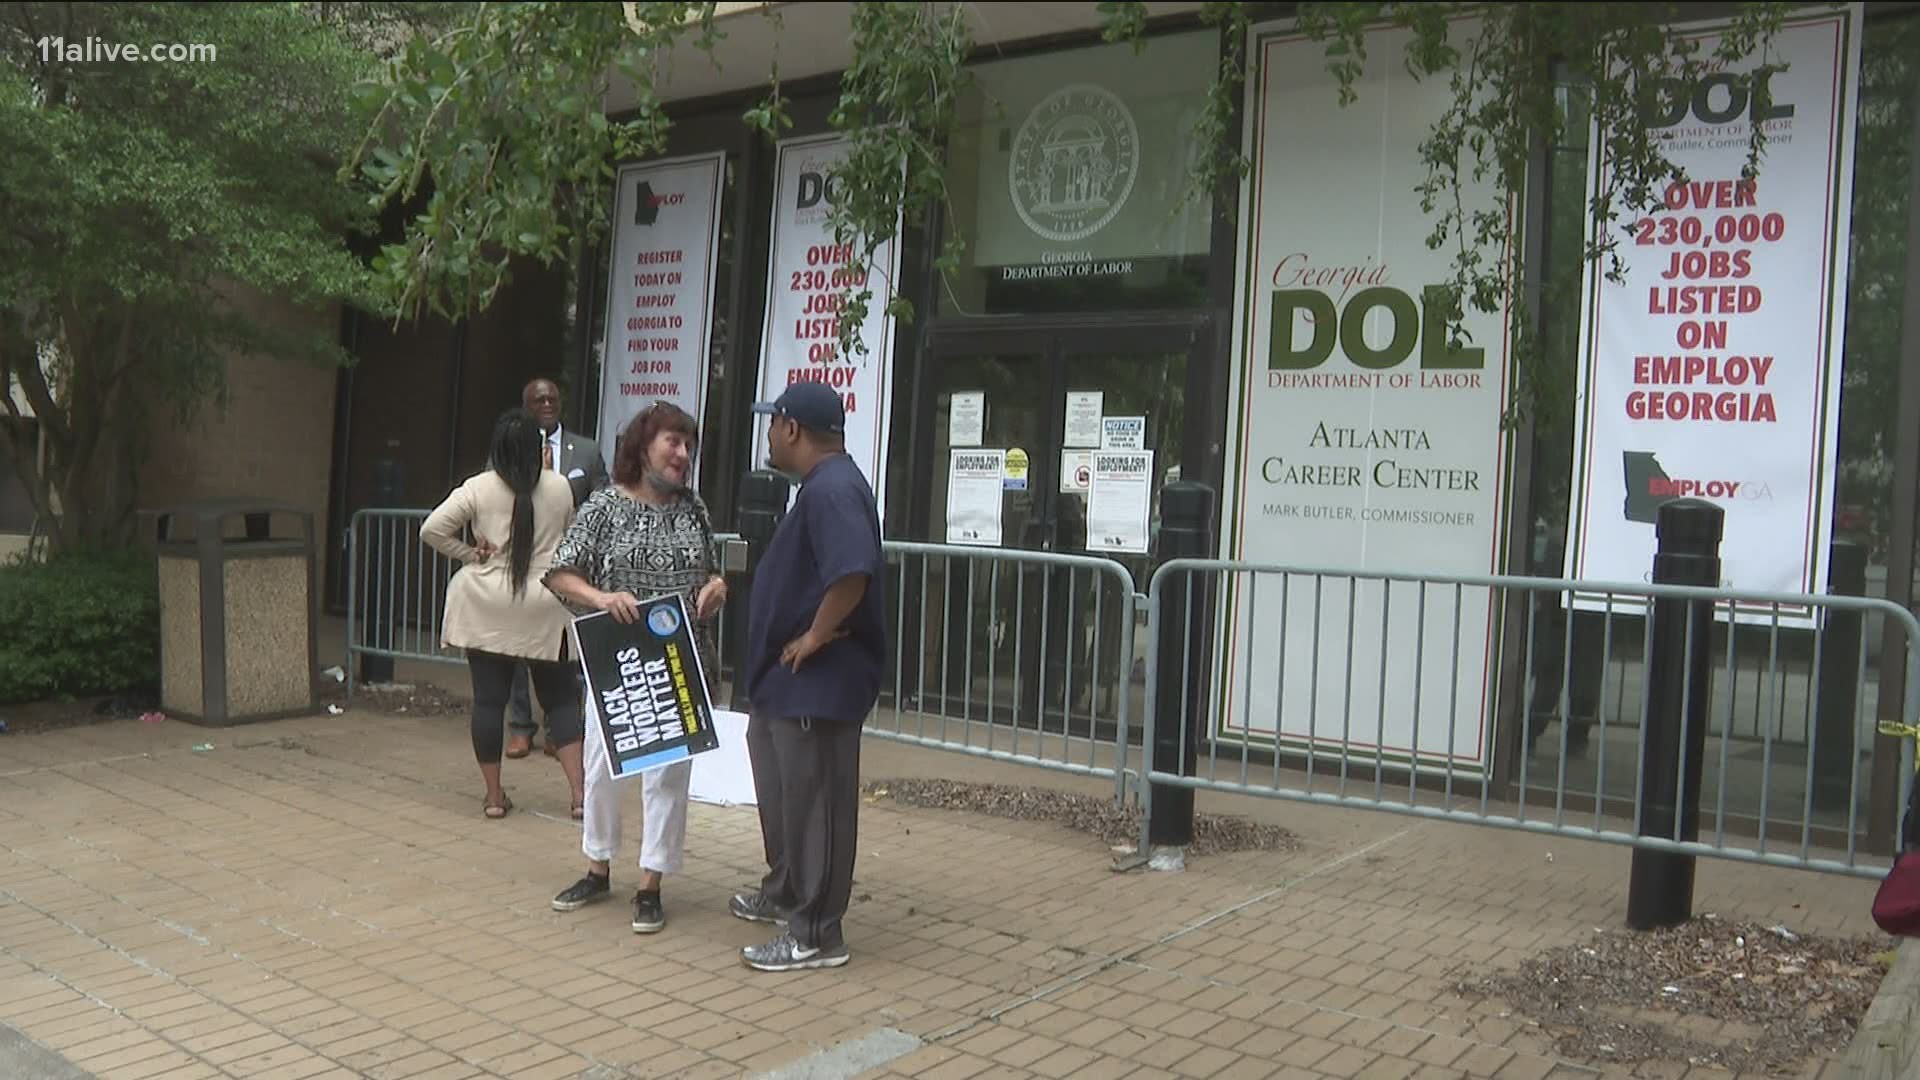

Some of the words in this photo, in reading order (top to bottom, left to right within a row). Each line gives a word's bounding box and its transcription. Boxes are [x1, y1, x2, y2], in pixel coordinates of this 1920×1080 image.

[1664, 180, 1757, 211] OVER
[1636, 213, 1785, 248] 230,000
[637, 251, 683, 265] REGISTER
[807, 240, 854, 266] OVER
[1041, 251, 1093, 265] GEORGIA
[1661, 250, 1752, 279] JOBS
[634, 273, 666, 287] TODAY
[667, 272, 682, 285] ON
[791, 268, 866, 292] 230,000
[1003, 265, 1075, 280] DEPARTMENT
[1076, 264, 1092, 276] OF
[1094, 261, 1133, 275] LABOR
[1273, 252, 1390, 323] Georgia
[636, 294, 676, 308] EMPLOY
[1648, 286, 1763, 314] LISTED
[627, 316, 667, 330] GEORGIA
[669, 315, 682, 329] TO
[1268, 285, 1485, 370] DOL
[628, 339, 648, 353] FIND
[650, 338, 679, 352] YOUR
[1676, 321, 1727, 349] ON
[809, 343, 836, 364] ON
[631, 361, 649, 374] JOB
[650, 361, 671, 374] FOR
[1633, 357, 1774, 386] EMPLOY
[620, 383, 680, 396] TOMORROW.
[1268, 372, 1384, 389] DEPARTMENT
[1389, 372, 1412, 388] OF
[1420, 371, 1481, 389] LABOR
[1625, 391, 1777, 422] GEORGIA
[1310, 421, 1431, 450] ATLANTA
[955, 456, 985, 464] LOOKING
[987, 455, 1000, 463] FOR
[1096, 464, 1146, 472] EMPLOYMENT?
[1097, 456, 1129, 464] LOOKING
[1262, 456, 1361, 487] CAREER
[1373, 459, 1480, 491] CENTER
[1262, 504, 1299, 517] MARK
[1303, 505, 1356, 521] BUTLER,
[1361, 508, 1475, 526] COMMISSIONER
[616, 647, 661, 747] WORKERS
[644, 657, 685, 742] MATTER
[601, 685, 640, 754] BLACK
